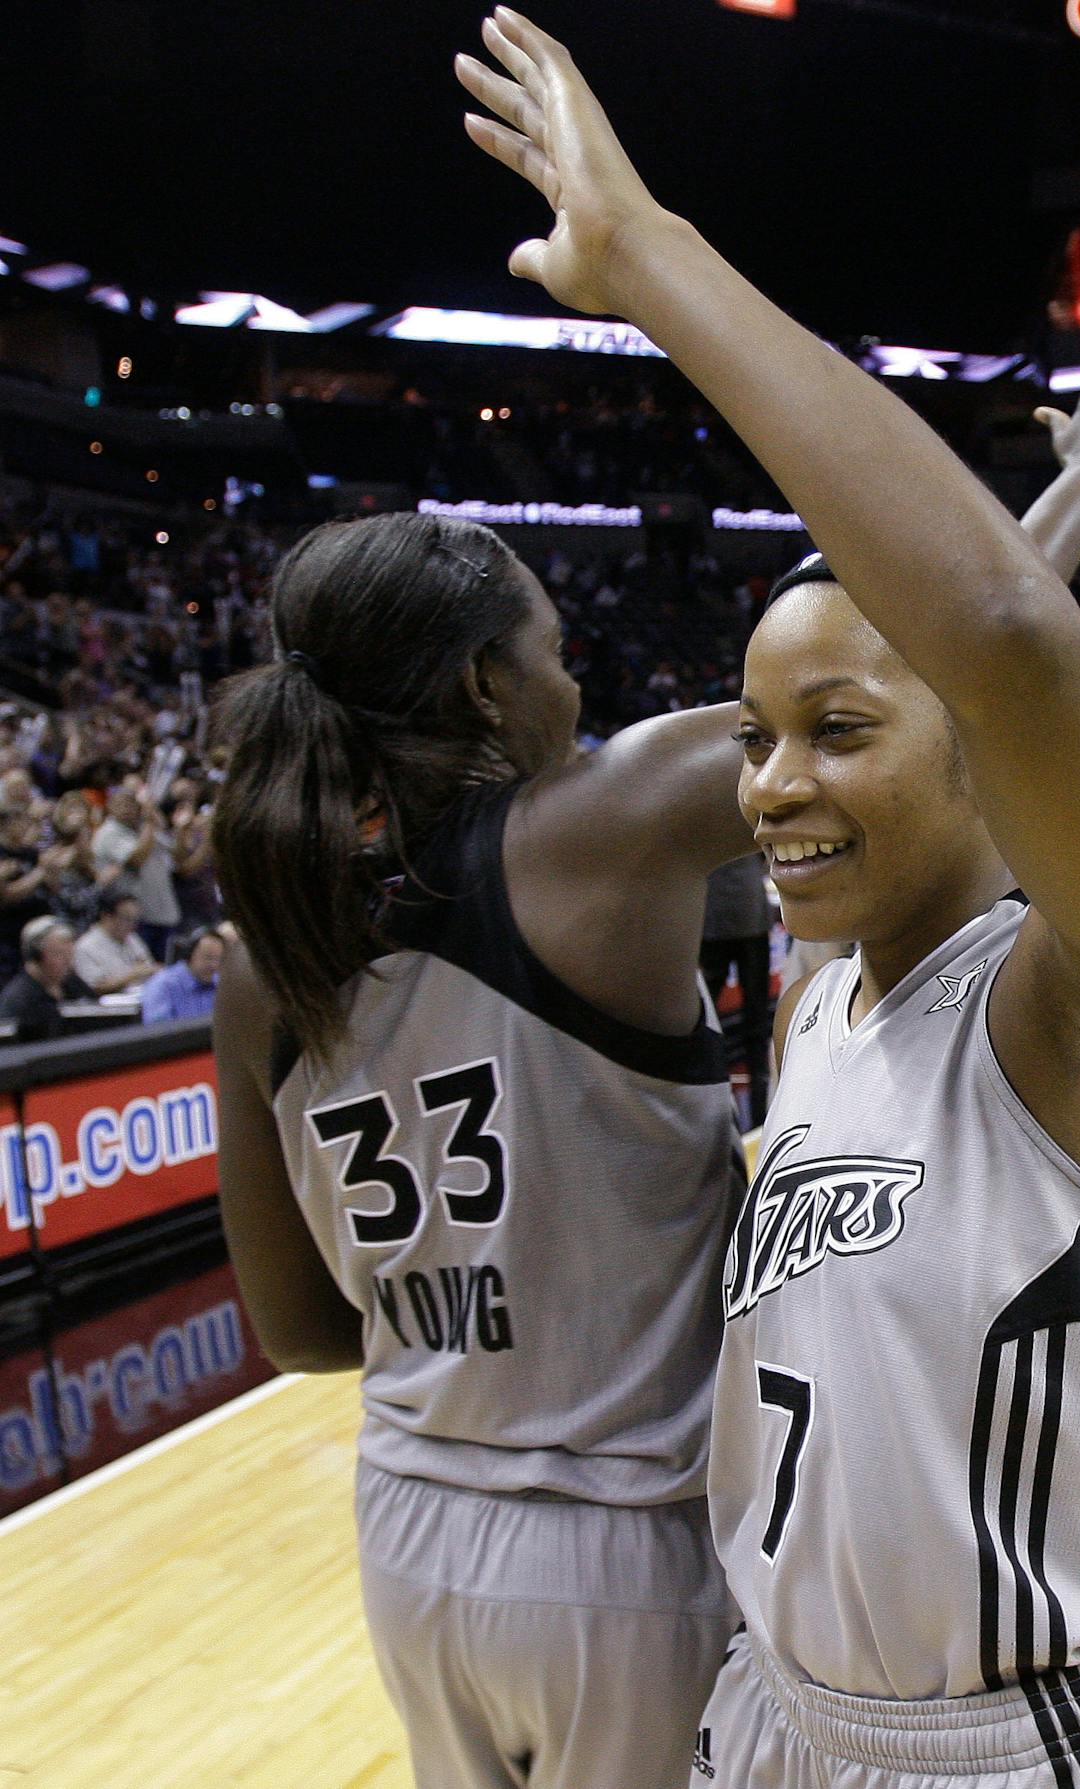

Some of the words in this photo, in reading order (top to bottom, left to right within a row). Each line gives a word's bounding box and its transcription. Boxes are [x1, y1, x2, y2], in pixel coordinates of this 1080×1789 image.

[305, 1056, 512, 1248] 33
[722, 1123, 925, 1322] STARS
[756, 1362, 816, 1568] 7
